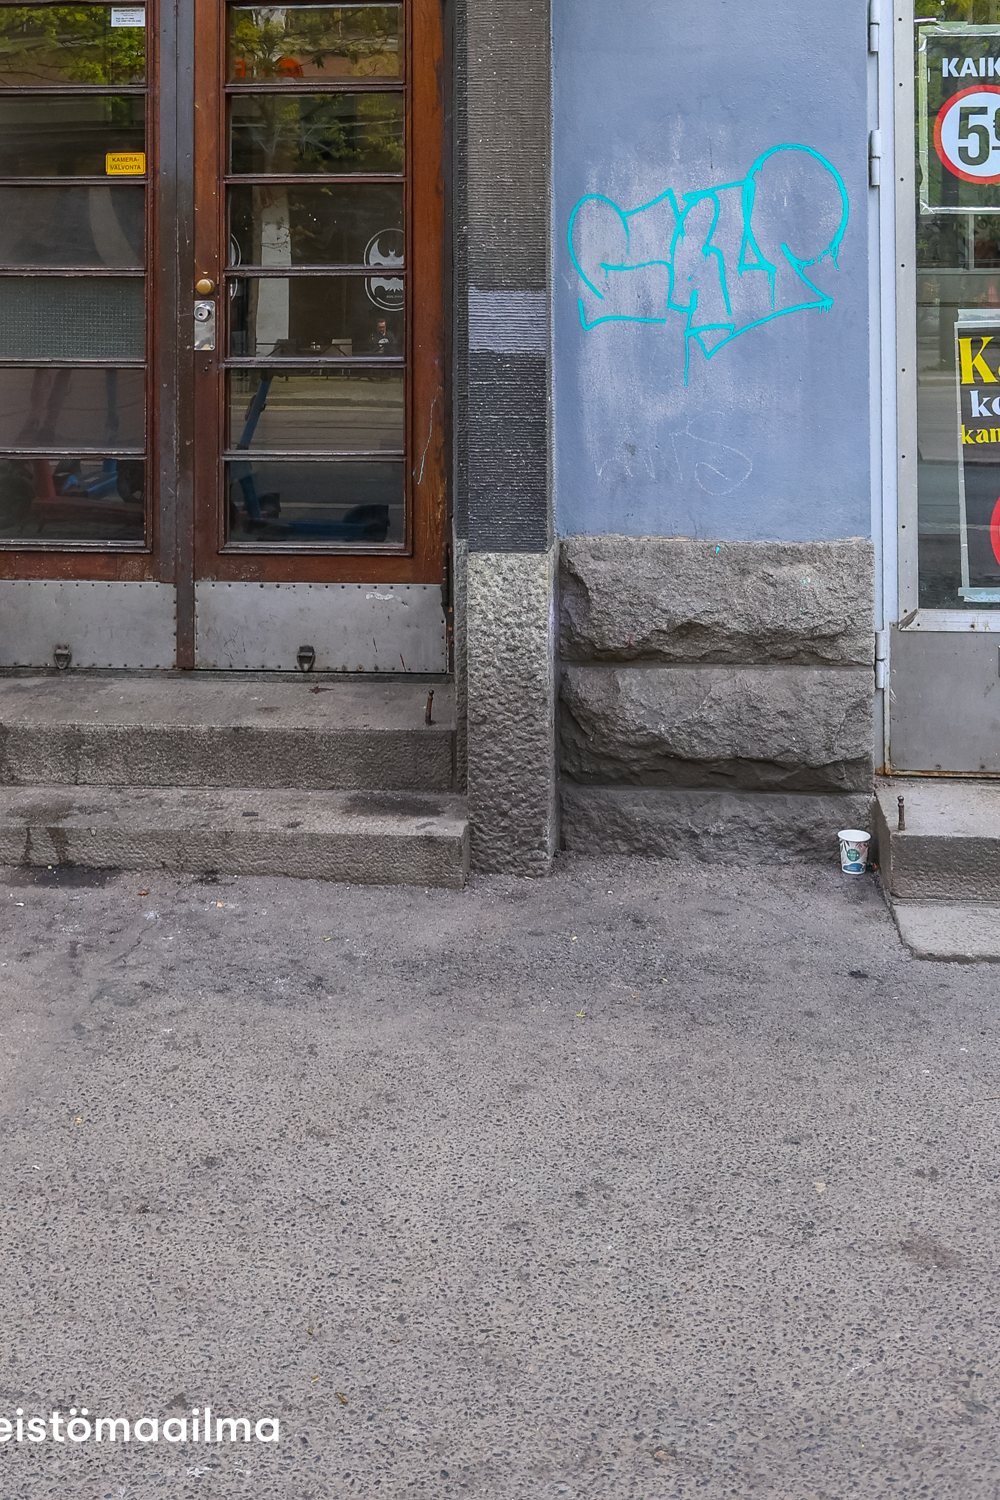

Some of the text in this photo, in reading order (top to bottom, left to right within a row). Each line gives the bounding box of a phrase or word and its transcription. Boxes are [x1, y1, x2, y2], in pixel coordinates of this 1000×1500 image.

[942, 57, 1000, 78] KAIK
[957, 106, 1000, 167] 5
[958, 336, 1000, 384] K
